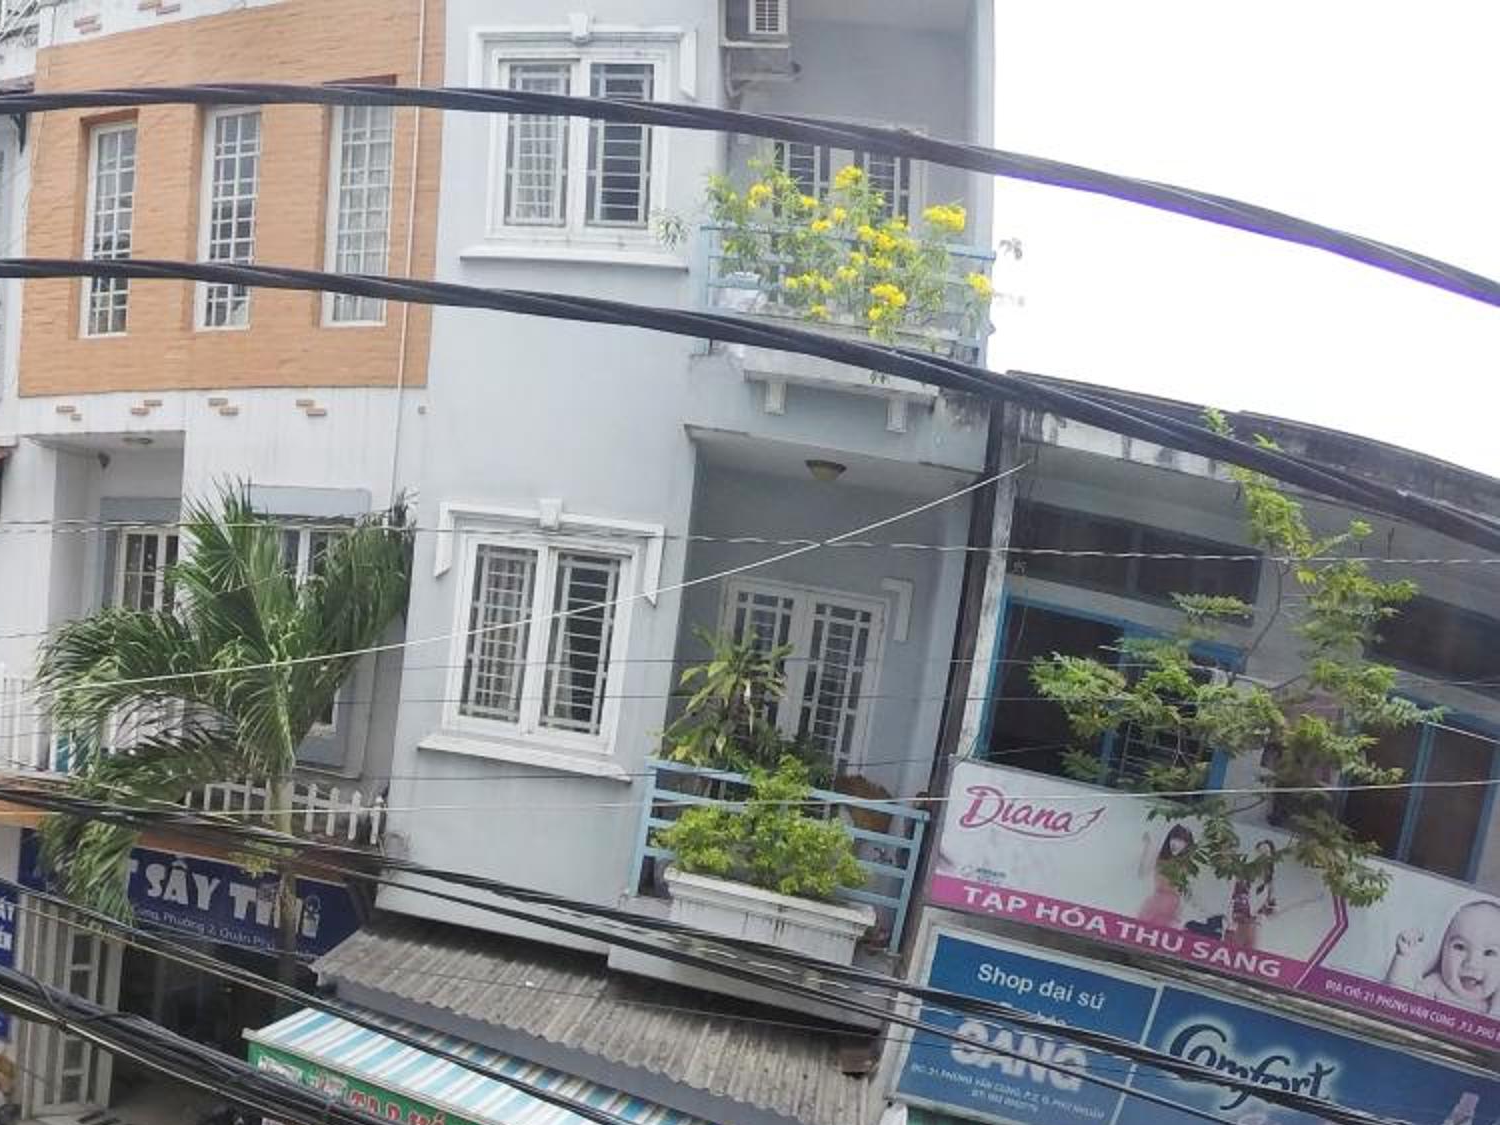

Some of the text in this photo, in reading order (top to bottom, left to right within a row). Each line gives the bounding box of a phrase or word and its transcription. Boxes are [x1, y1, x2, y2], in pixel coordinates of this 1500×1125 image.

[959, 784, 1074, 834] Diana
[963, 885, 1282, 979] TẠP HÓA THU SANG
[977, 963, 1033, 995] Shop
[1039, 980, 1074, 1004] đại
[950, 1021, 1088, 1093] SANG
